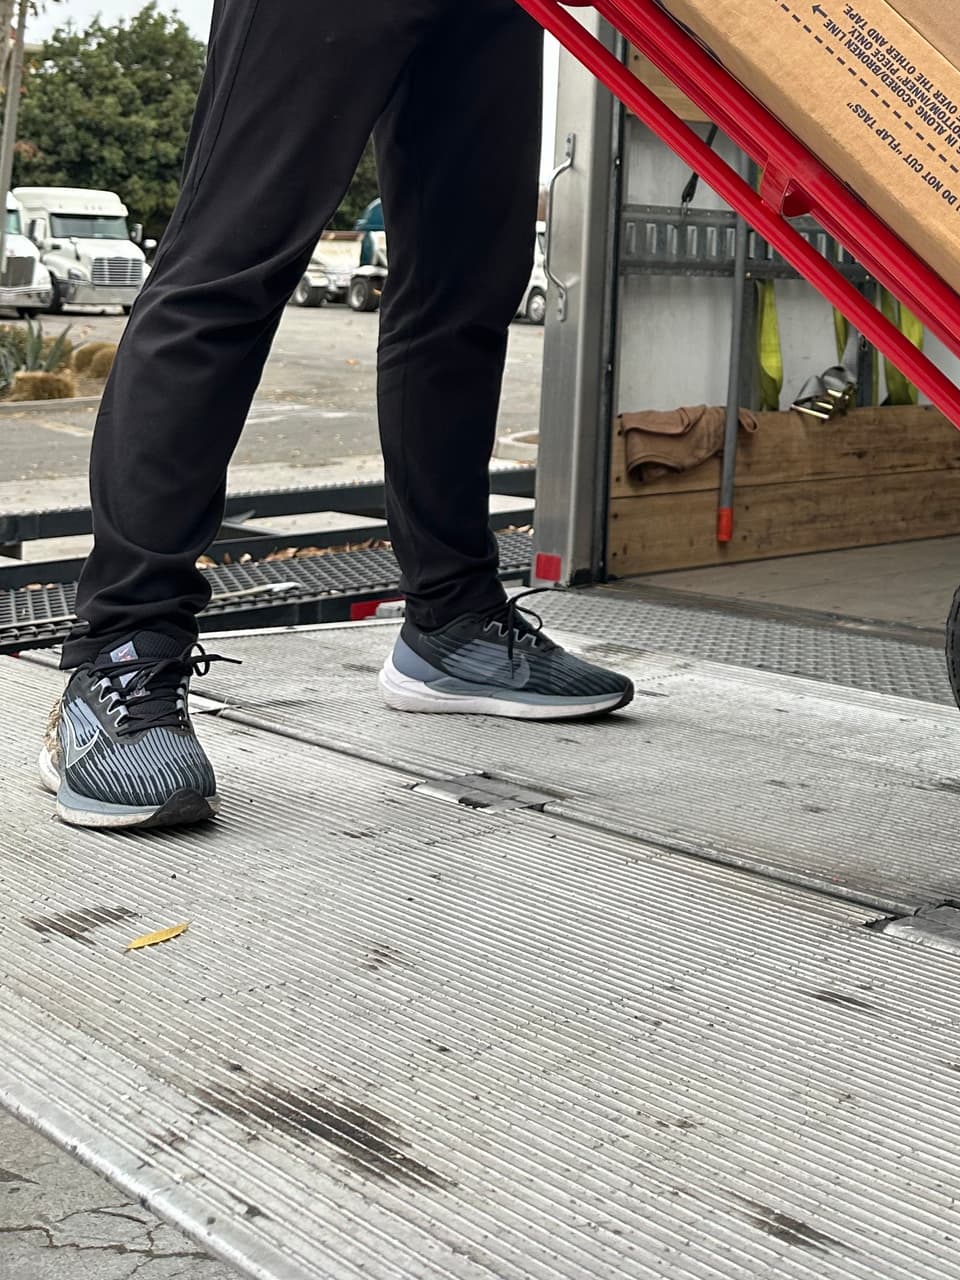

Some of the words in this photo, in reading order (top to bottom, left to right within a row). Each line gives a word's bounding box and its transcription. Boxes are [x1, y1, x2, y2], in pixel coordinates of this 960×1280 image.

[842, 3, 868, 31] TAPE.
[822, 18, 847, 42] LINE
[847, 25, 874, 51] ONLY.
[866, 28, 889, 48] AND
[870, 47, 900, 76] PIECE
[885, 44, 917, 75] OTHER
[844, 38, 917, 108] SCORED/BROKEN
[913, 72, 934, 93] THE
[932, 89, 958, 115] OVER
[914, 105, 948, 136] ALONG
[944, 133, 958, 148] IN
[902, 153, 924, 174] CUT
[921, 171, 944, 193] NOT
[941, 189, 958, 206] DO
